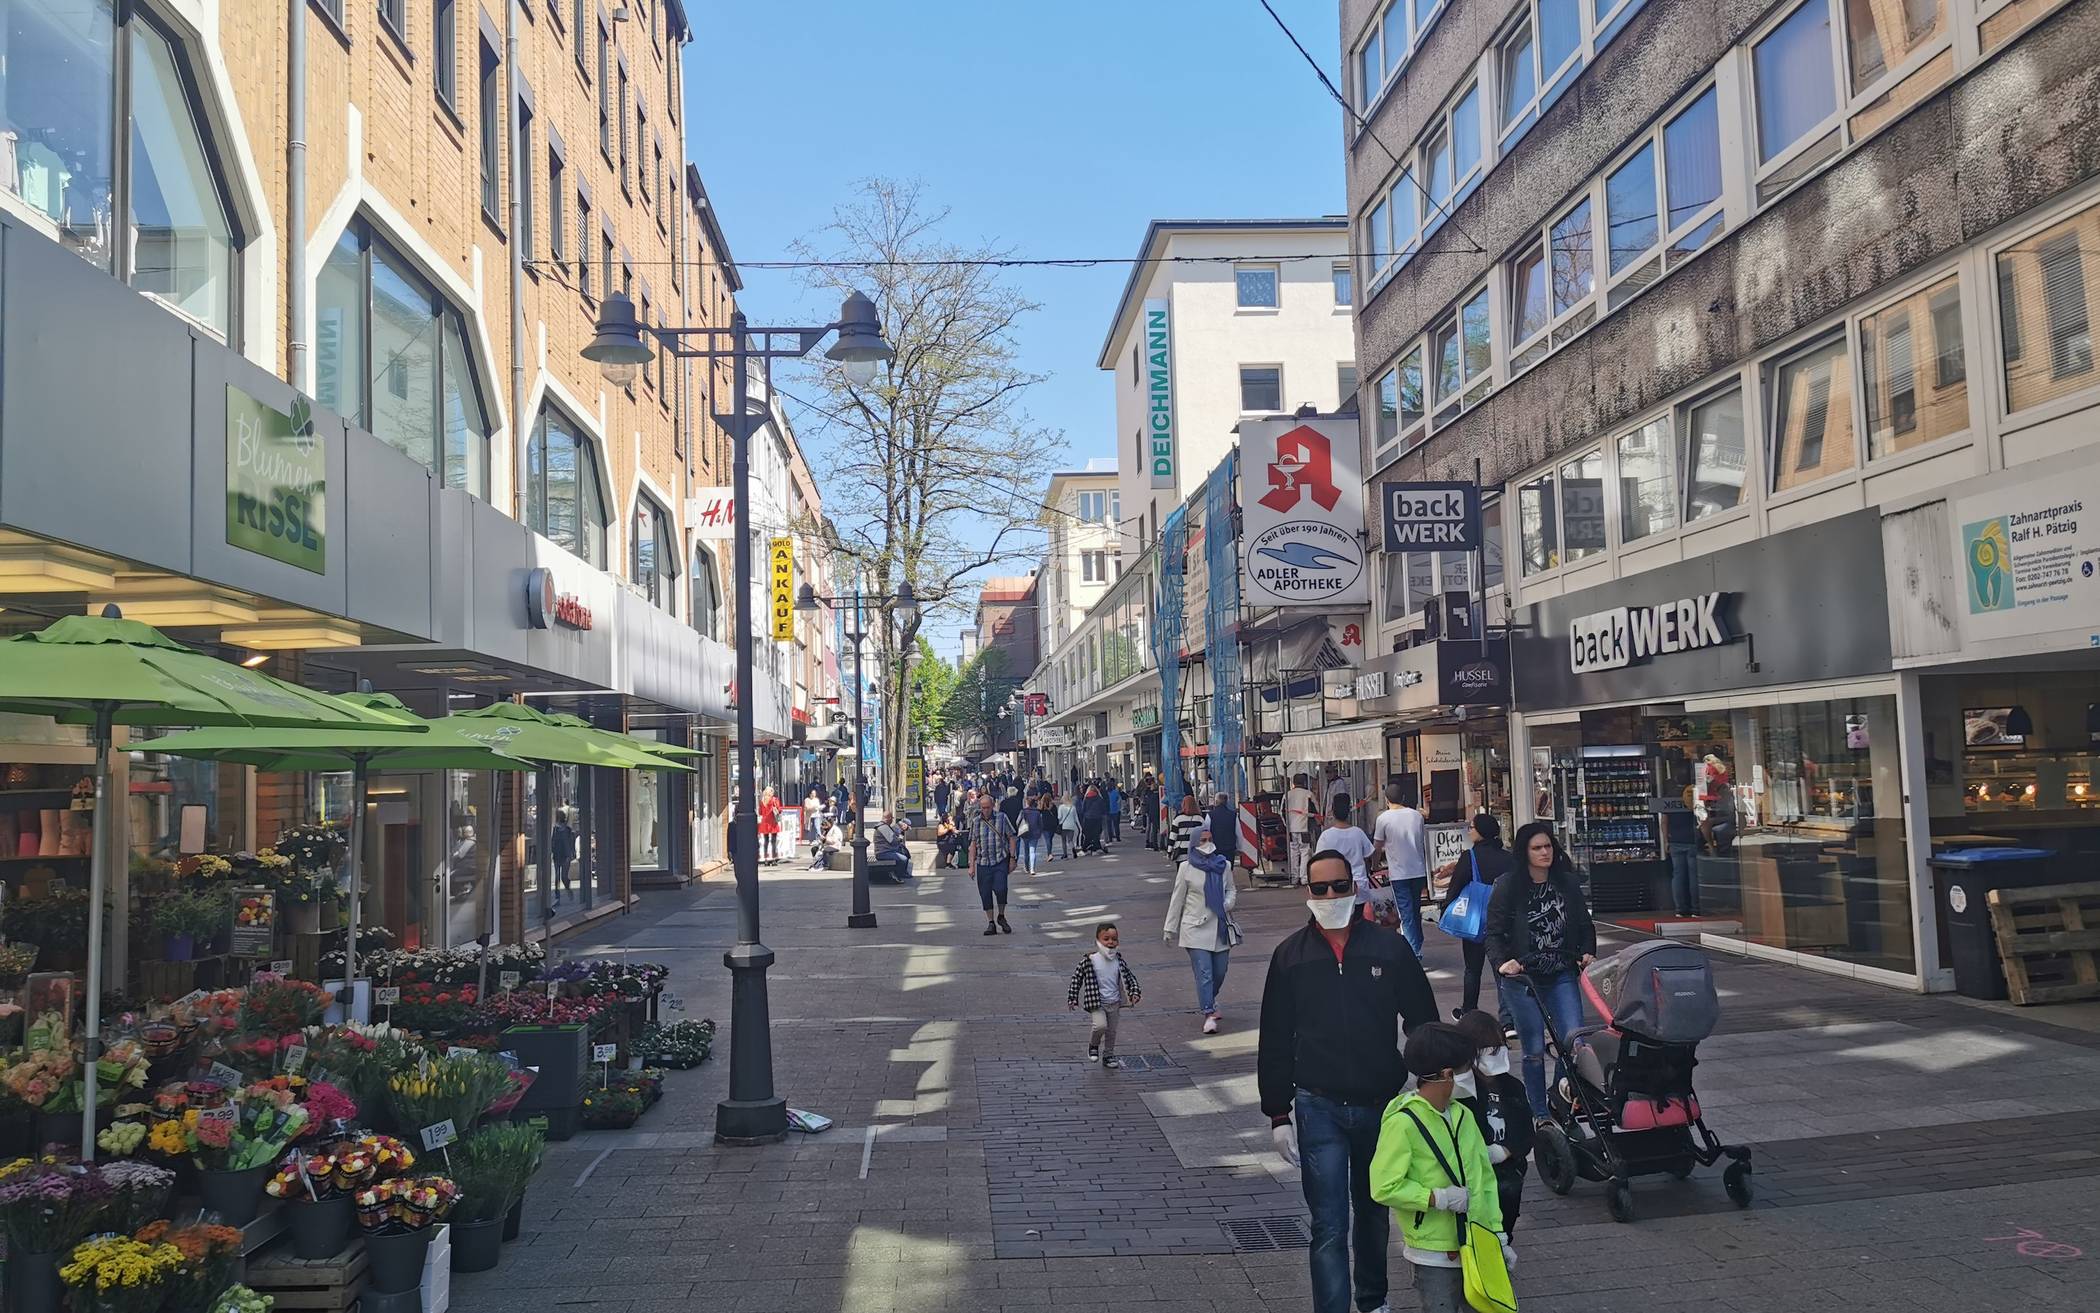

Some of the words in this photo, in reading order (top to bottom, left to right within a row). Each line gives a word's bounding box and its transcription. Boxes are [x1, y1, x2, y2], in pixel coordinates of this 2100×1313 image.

[1148, 310, 1171, 476] DEICHMANN
[235, 412, 319, 497] Blumen
[237, 474, 318, 551] RISSE
[1397, 493, 1460, 518] back
[2010, 499, 2083, 527] Zahnarztpraxis
[1261, 531, 1279, 546] Seit
[1280, 525, 1300, 536] über
[1302, 525, 1318, 533] 190
[1320, 525, 1348, 543] Jahren
[1394, 522, 1466, 543] WERK
[2011, 528, 2030, 543] Ralf
[2032, 526, 2043, 538] H.
[2046, 519, 2077, 536] Pätzig
[1257, 568, 1299, 580] ADLER
[1274, 578, 1343, 591] APOTHEKE
[775, 550, 789, 632] ANKAUF
[1573, 614, 1625, 667] back
[1630, 591, 1723, 658] WERK
[1356, 672, 1388, 701] HUSSEL
[1454, 670, 1494, 681] HUSSEL
[1437, 831, 1464, 847] Ofen
[428, 1124, 448, 1145] 1.99
